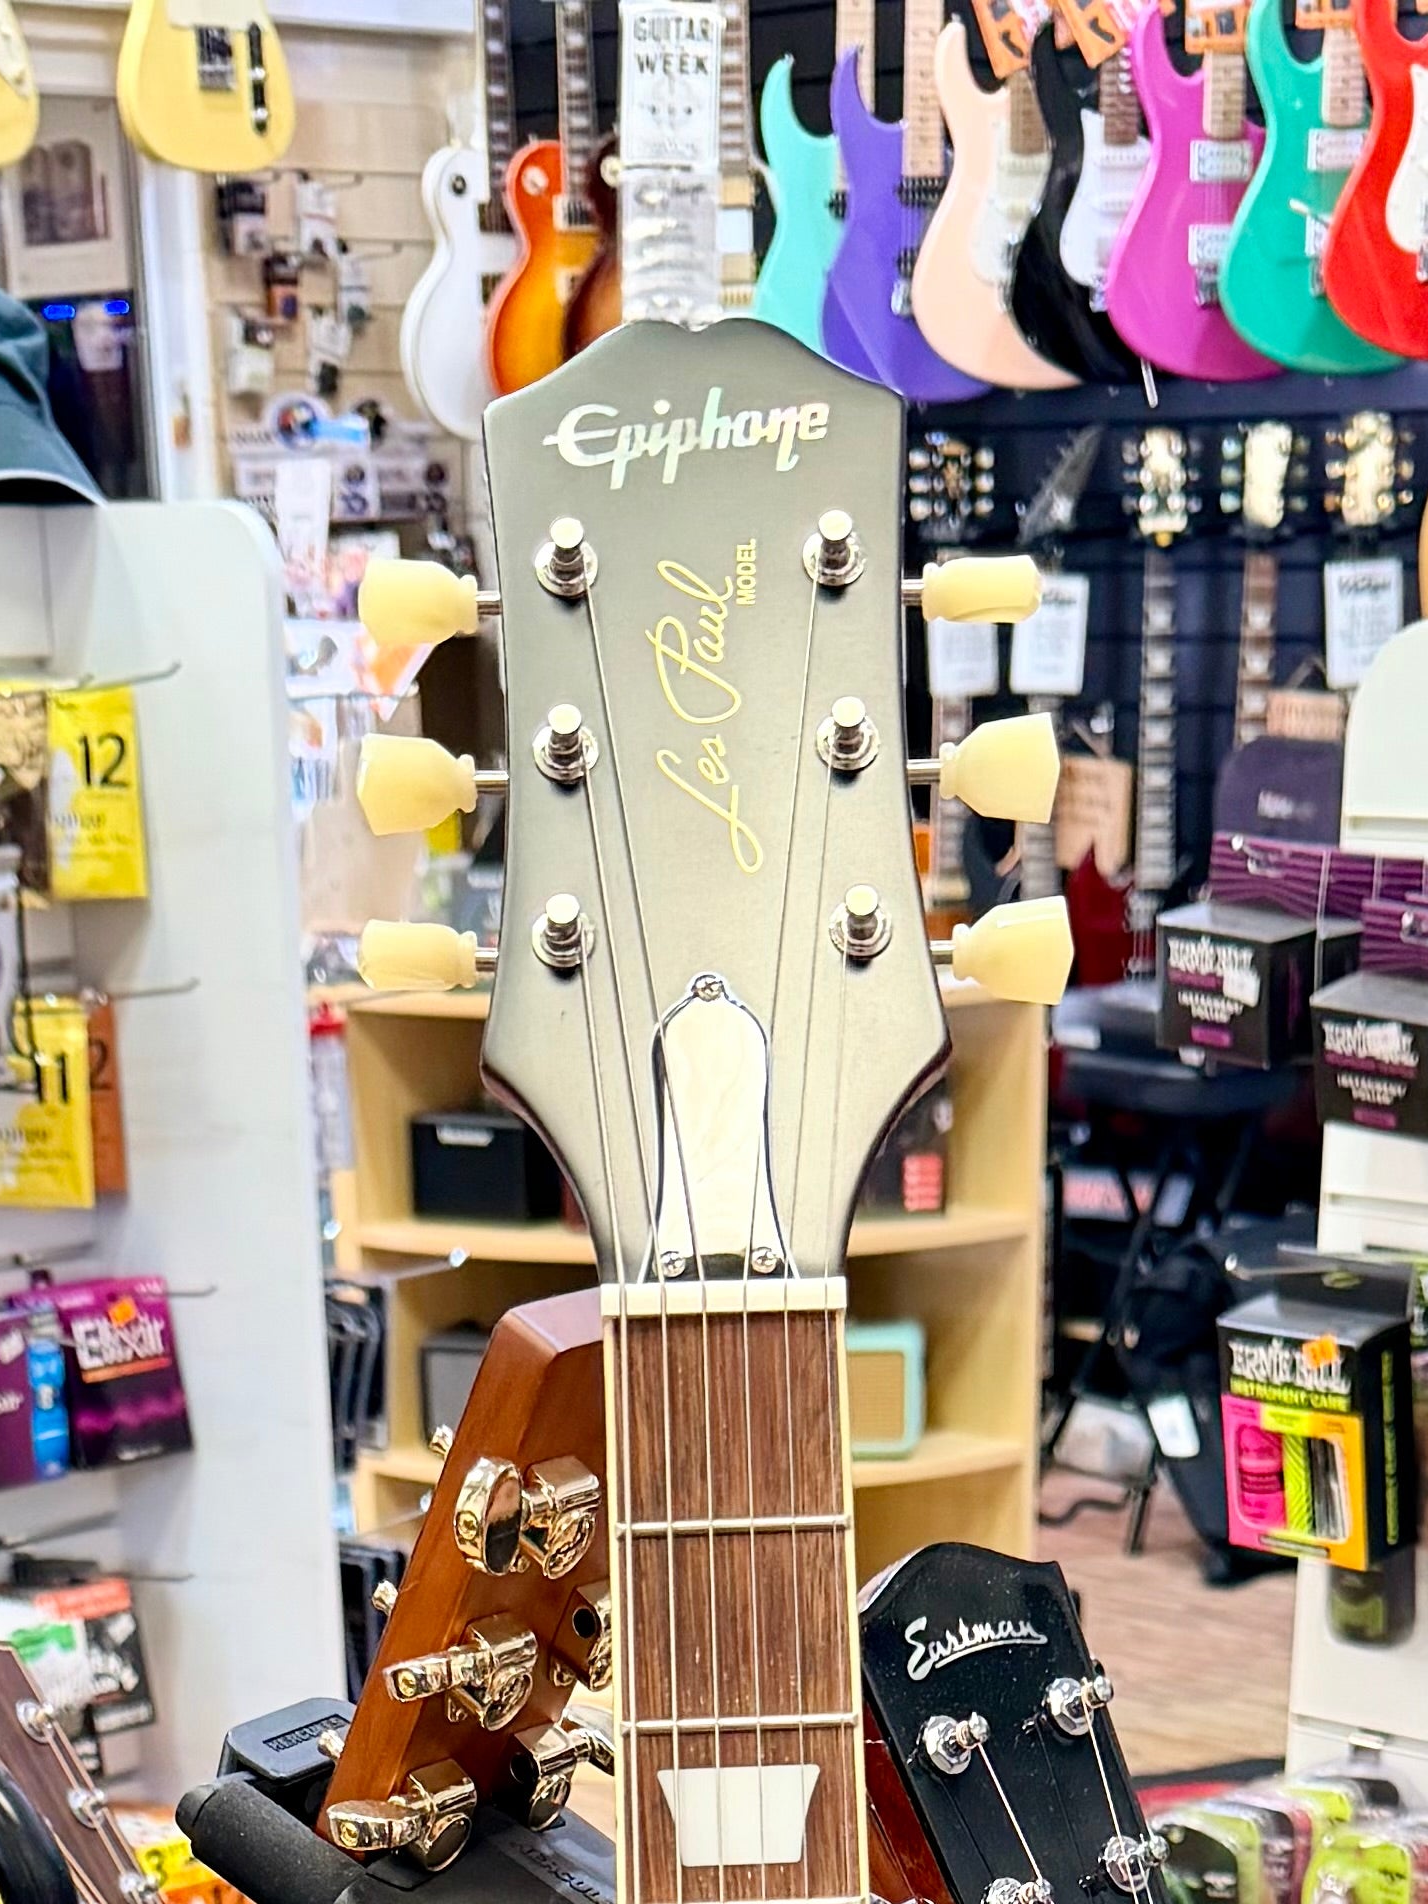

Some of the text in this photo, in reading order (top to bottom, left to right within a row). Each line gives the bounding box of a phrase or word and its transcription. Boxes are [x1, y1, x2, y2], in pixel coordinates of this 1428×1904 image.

[633, 16, 713, 42] GUITAR
[637, 53, 709, 75] WEEK
[542, 386, 829, 489] Epiphone
[736, 538, 757, 606] MODEL
[646, 560, 762, 874] Les Paul
[79, 732, 129, 790] 12
[1228, 1336, 1292, 1383] ERNIE
[904, 1616, 1049, 1682] Eastman
